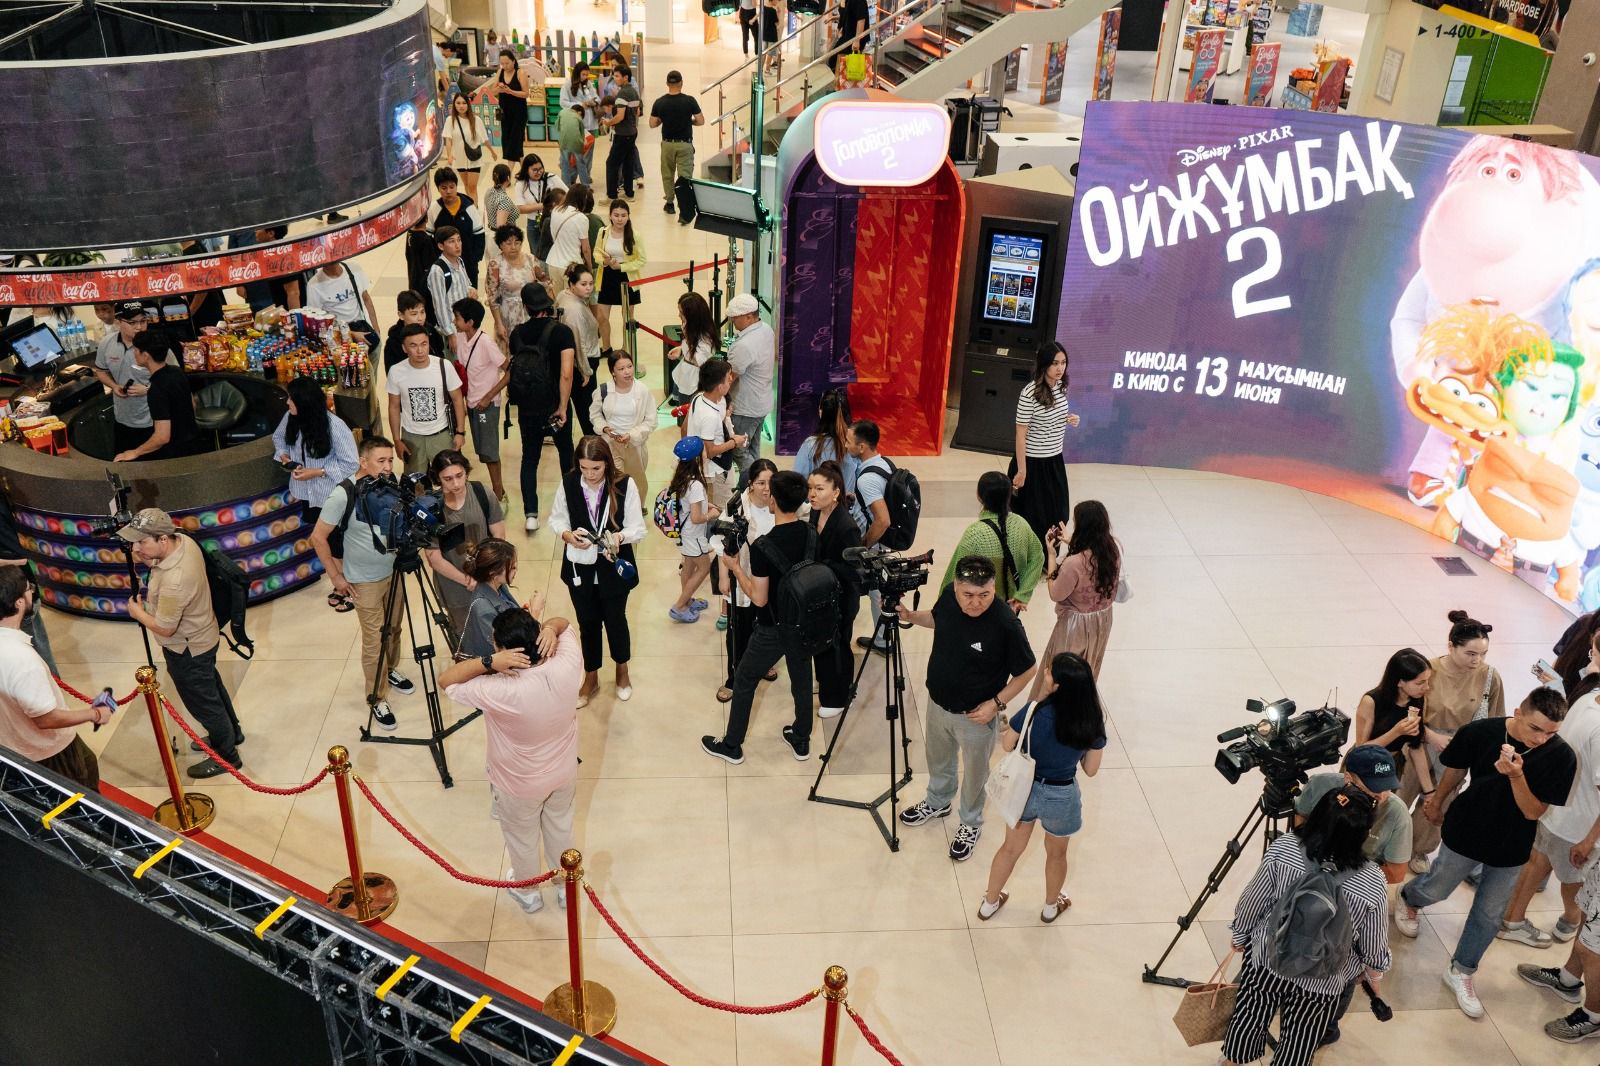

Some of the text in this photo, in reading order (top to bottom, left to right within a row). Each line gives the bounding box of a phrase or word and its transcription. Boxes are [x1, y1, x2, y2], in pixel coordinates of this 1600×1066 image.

[1498, 0, 1541, 19] WARDROBE
[1435, 24, 1476, 38] 1-400
[1238, 125, 1294, 150] PIXAR
[880, 146, 899, 170] 2
[1080, 121, 1415, 267] ОЙЖҰМБАҚ
[1226, 227, 1292, 319] 2
[1124, 351, 1187, 372] КИНОДА
[1112, 373, 1185, 392] В КИНО С
[1195, 356, 1229, 397] 13
[1238, 360, 1347, 395] МАУСЫМНАН
[1233, 382, 1282, 404] ИЮНЯ
